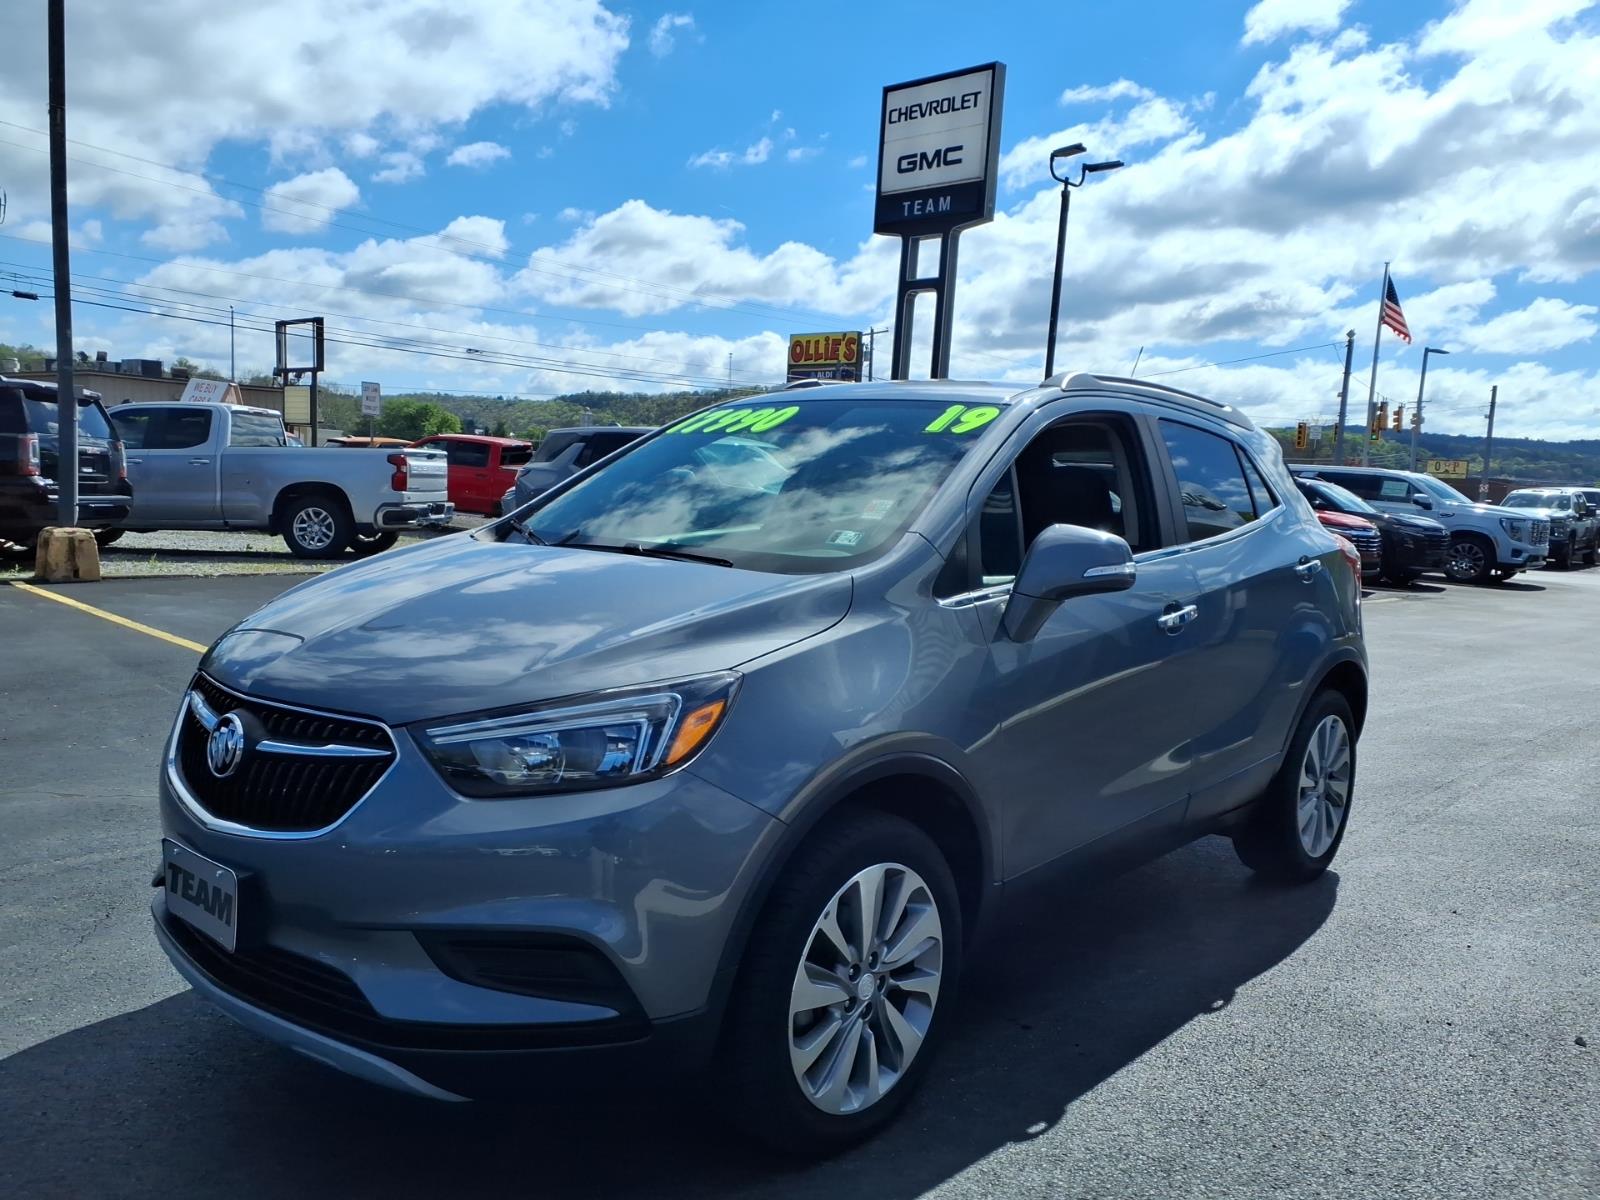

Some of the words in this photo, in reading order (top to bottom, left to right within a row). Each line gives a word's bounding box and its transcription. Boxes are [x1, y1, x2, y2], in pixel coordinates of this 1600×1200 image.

[888, 91, 982, 125] CHEVROLET
[897, 145, 964, 174] GMC
[903, 196, 951, 217] TEAM
[924, 404, 1000, 434] 19
[168, 862, 233, 928] TEAM
